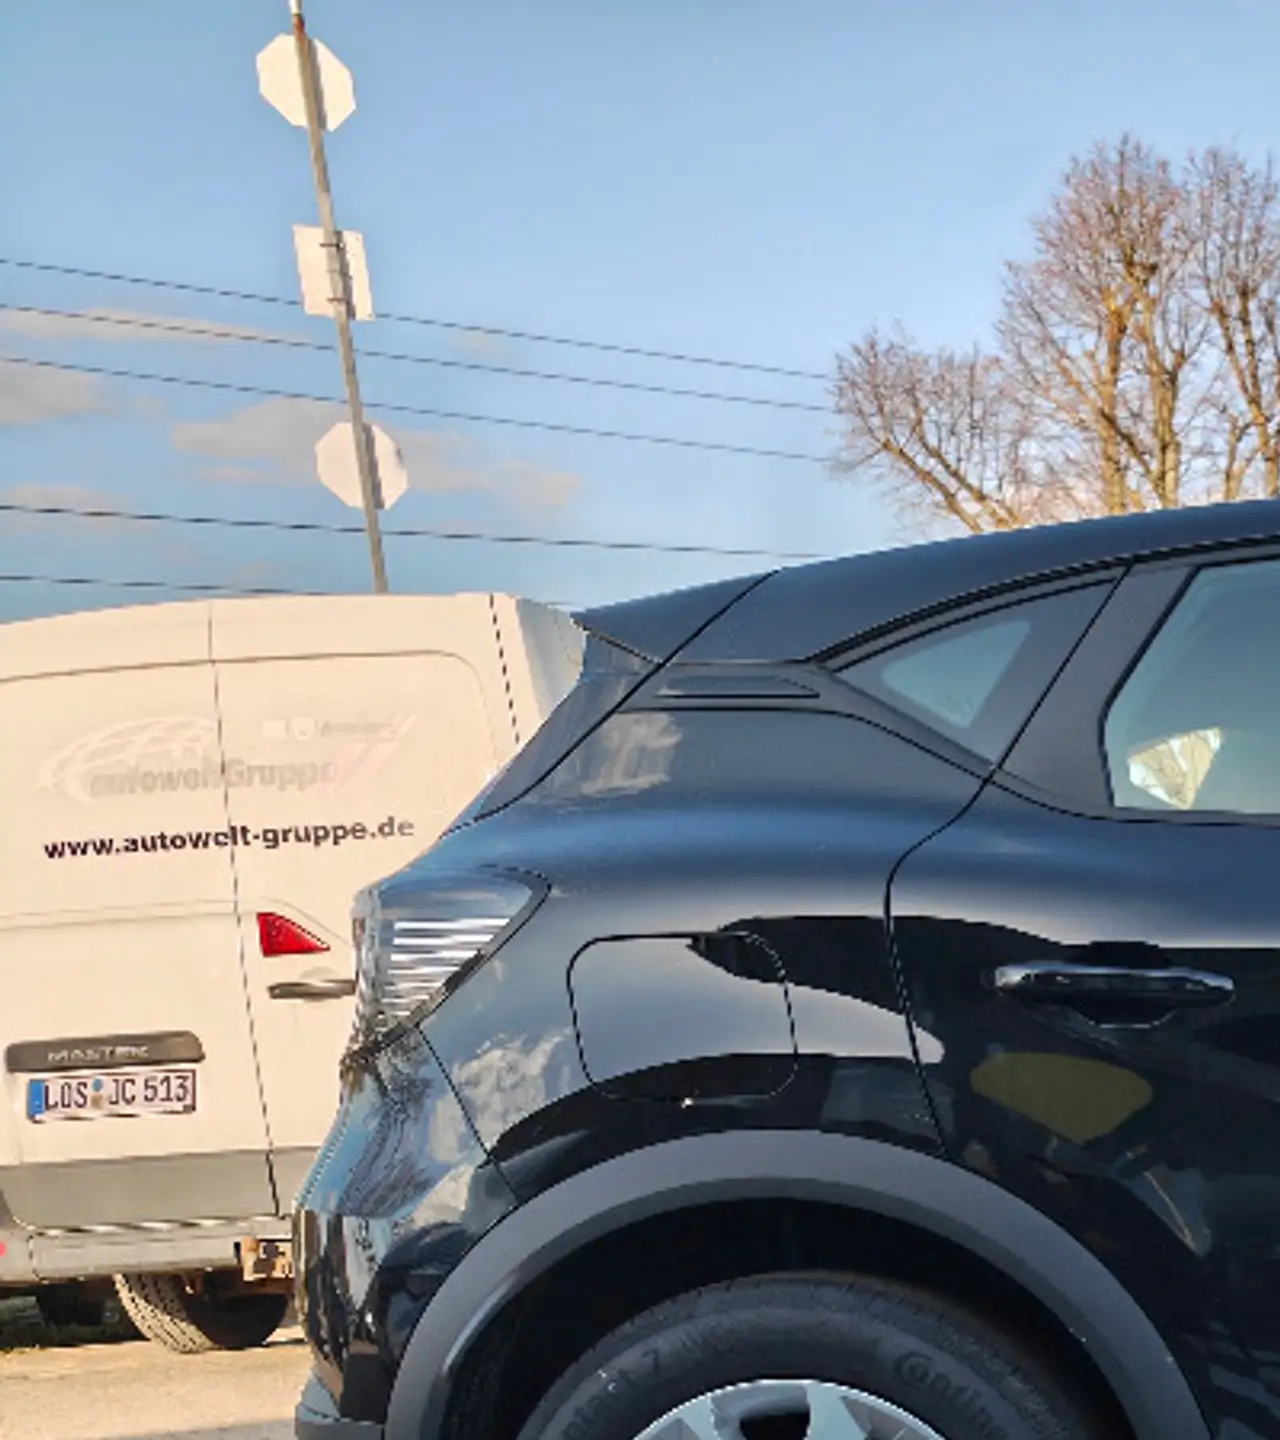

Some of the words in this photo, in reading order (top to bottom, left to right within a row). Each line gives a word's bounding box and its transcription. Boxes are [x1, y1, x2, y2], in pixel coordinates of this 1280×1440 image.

[43, 815, 413, 859] www.autowelt-gruppe.de
[45, 1078, 88, 1111] LOS
[108, 1077, 137, 1106] JC
[143, 1074, 192, 1103] 513
